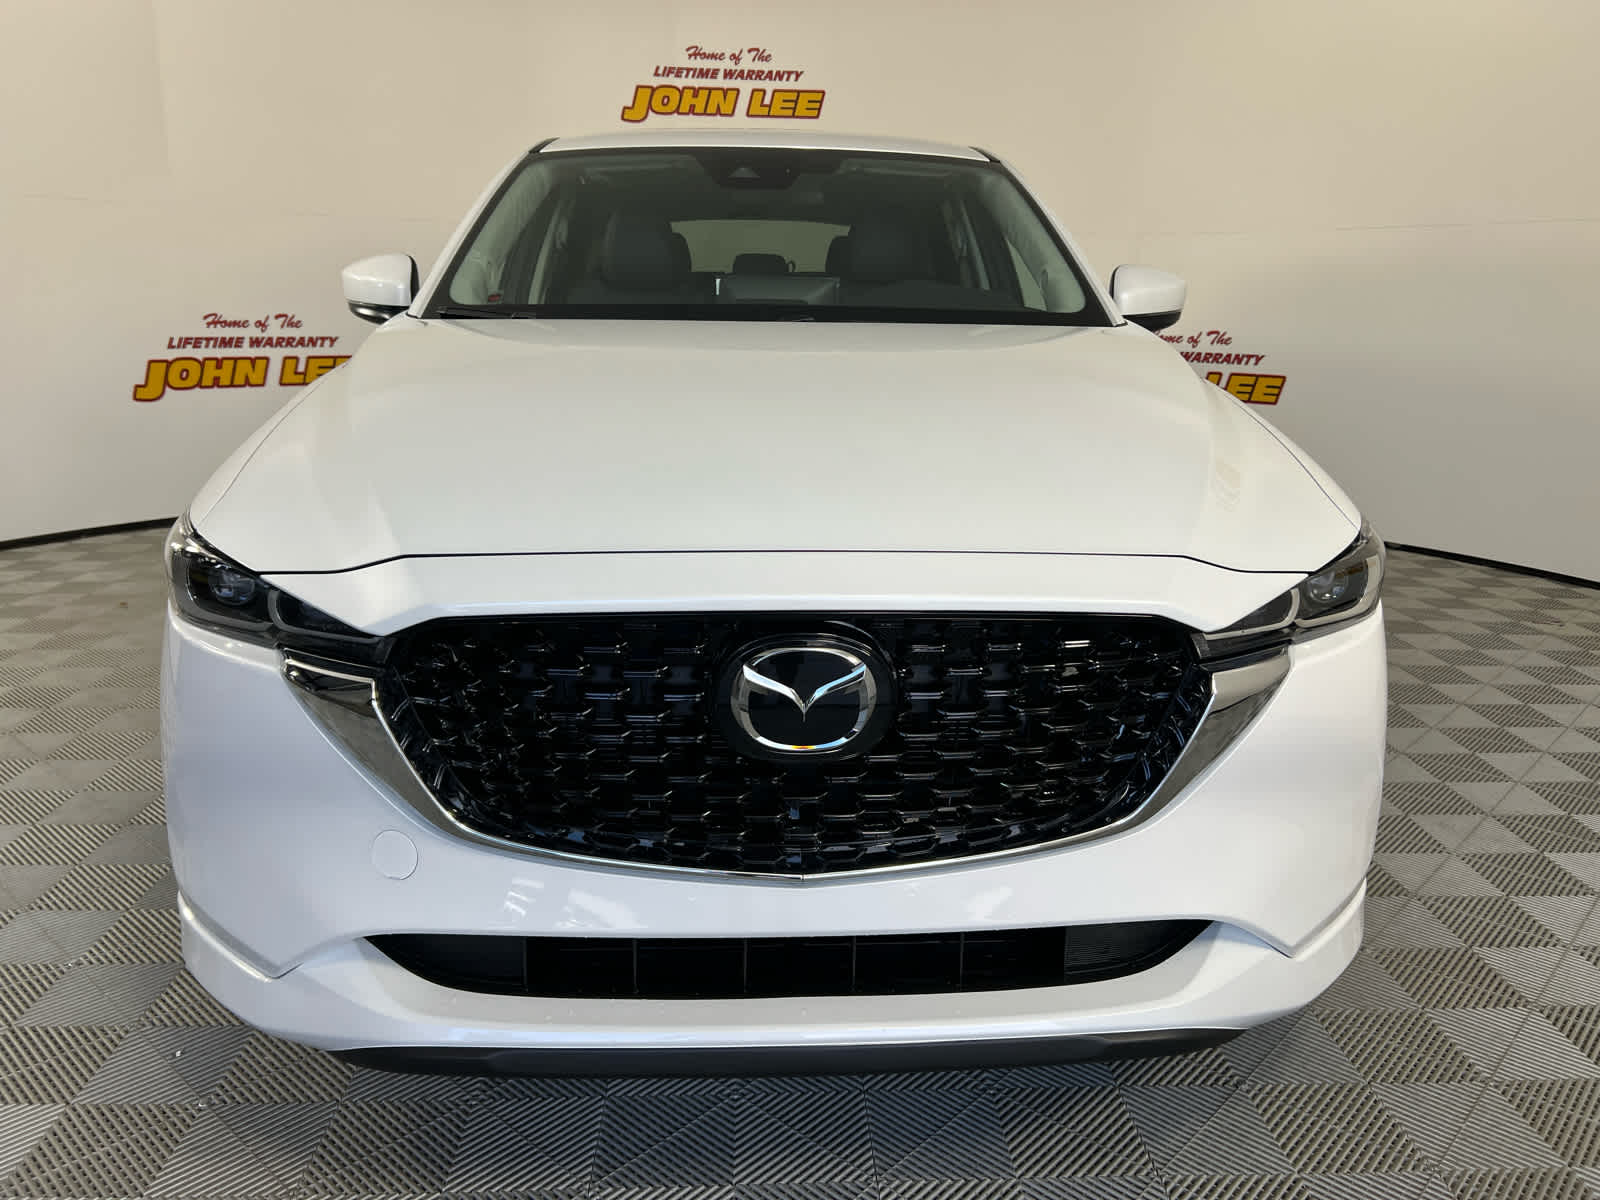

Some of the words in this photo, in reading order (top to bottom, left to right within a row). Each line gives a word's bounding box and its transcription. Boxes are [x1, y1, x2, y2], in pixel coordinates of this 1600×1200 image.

[685, 45, 725, 61] Home
[729, 48, 743, 65] of
[747, 48, 772, 62] The
[653, 65, 720, 79] LIFETIME
[723, 68, 804, 82] WARRANTY
[621, 84, 740, 122] JOHN
[746, 88, 825, 119] LEE
[203, 313, 250, 329] Home
[254, 315, 270, 332] of
[274, 313, 303, 329] The
[167, 336, 245, 349] LIFETIME
[249, 336, 339, 348] WARRANTY
[1187, 331, 1202, 348] of
[1206, 330, 1232, 346] The
[1180, 351, 1265, 366] WARRANTY
[132, 356, 270, 402] JOHN
